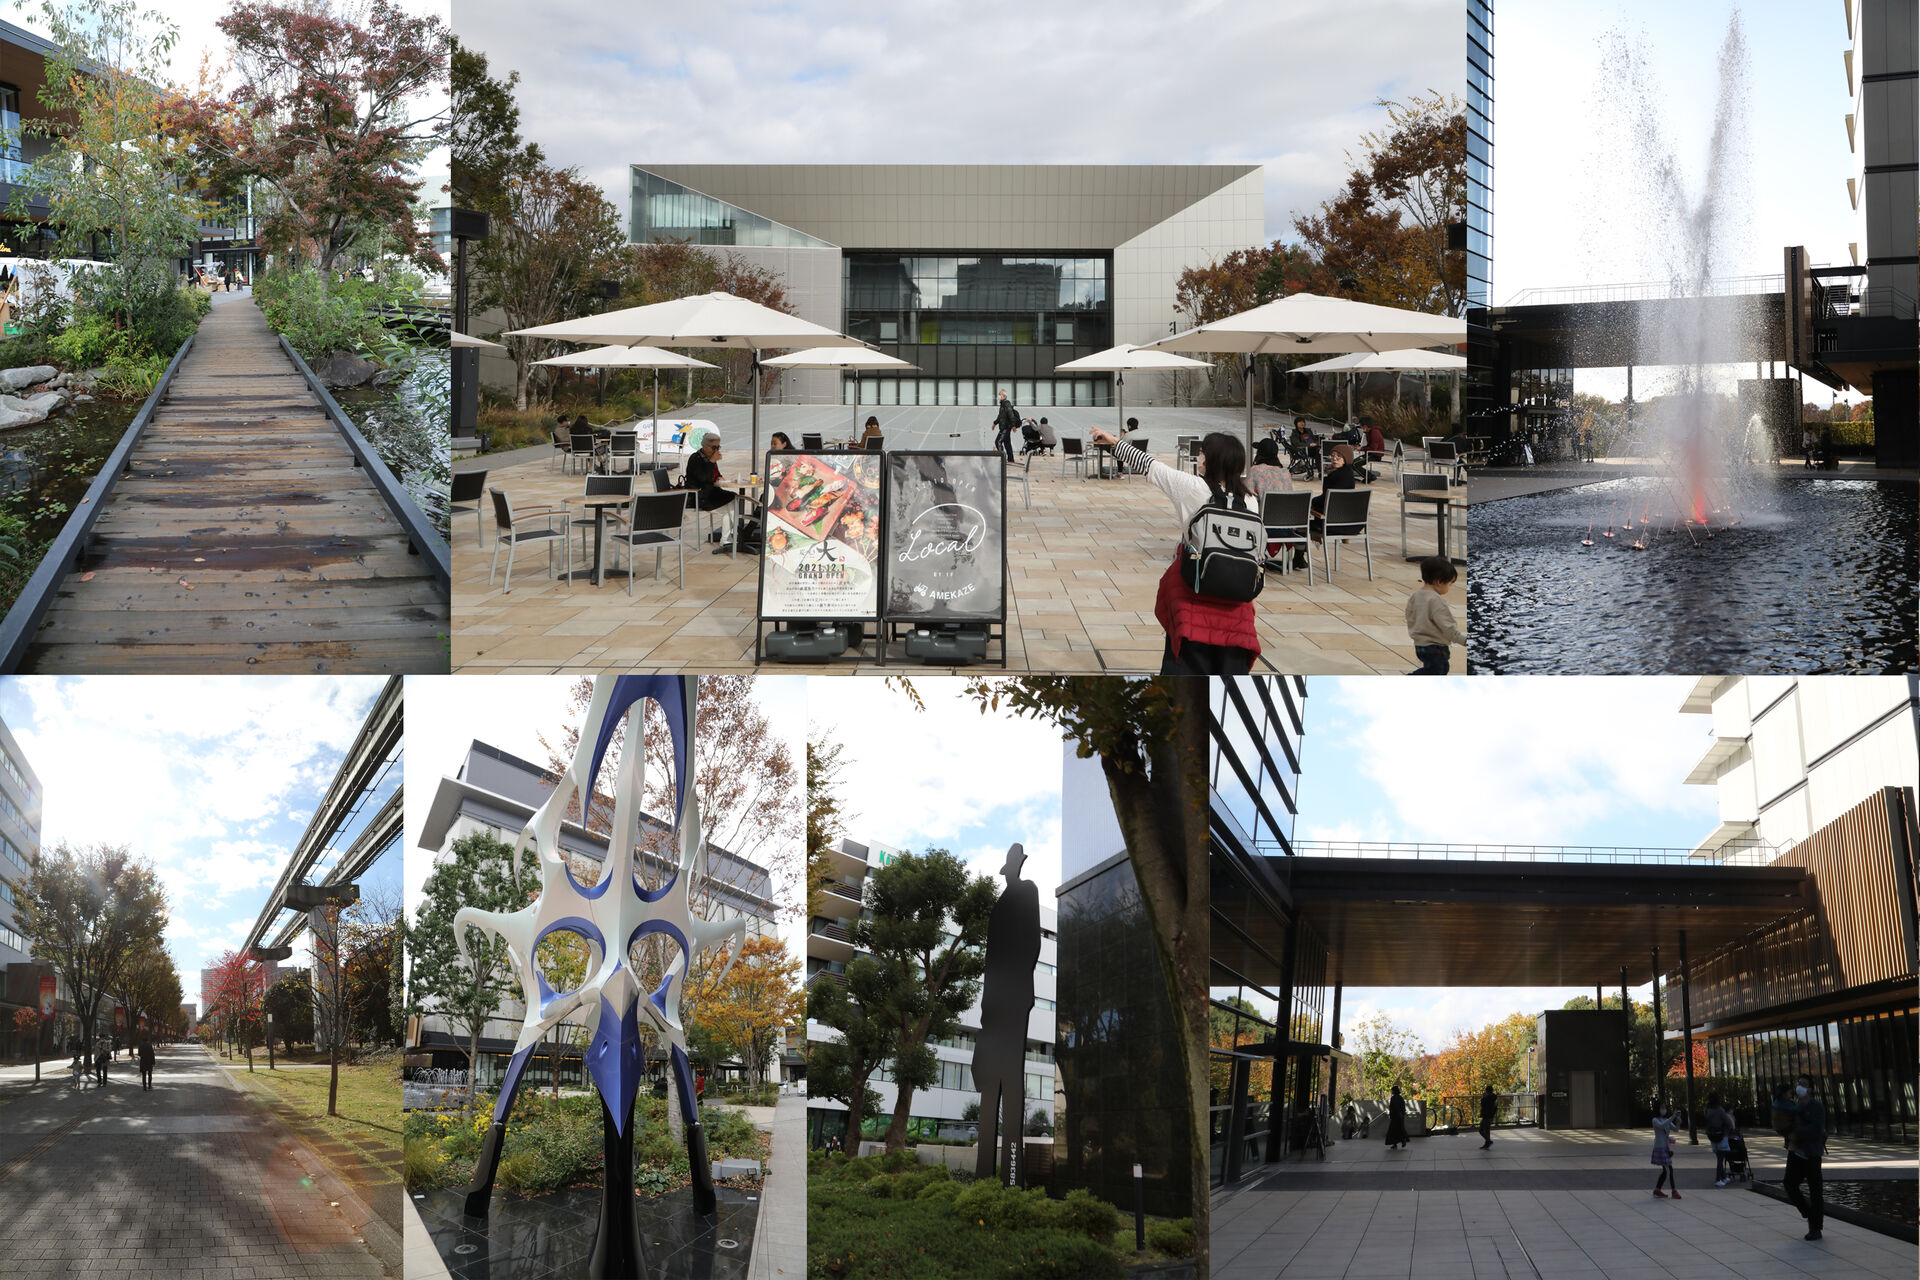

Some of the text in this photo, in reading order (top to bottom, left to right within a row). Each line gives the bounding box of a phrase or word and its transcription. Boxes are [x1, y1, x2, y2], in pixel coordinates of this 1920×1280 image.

[899, 514, 986, 562] Local
[798, 563, 845, 572] 2021.12.1
[929, 583, 976, 600] AMEKAZE
